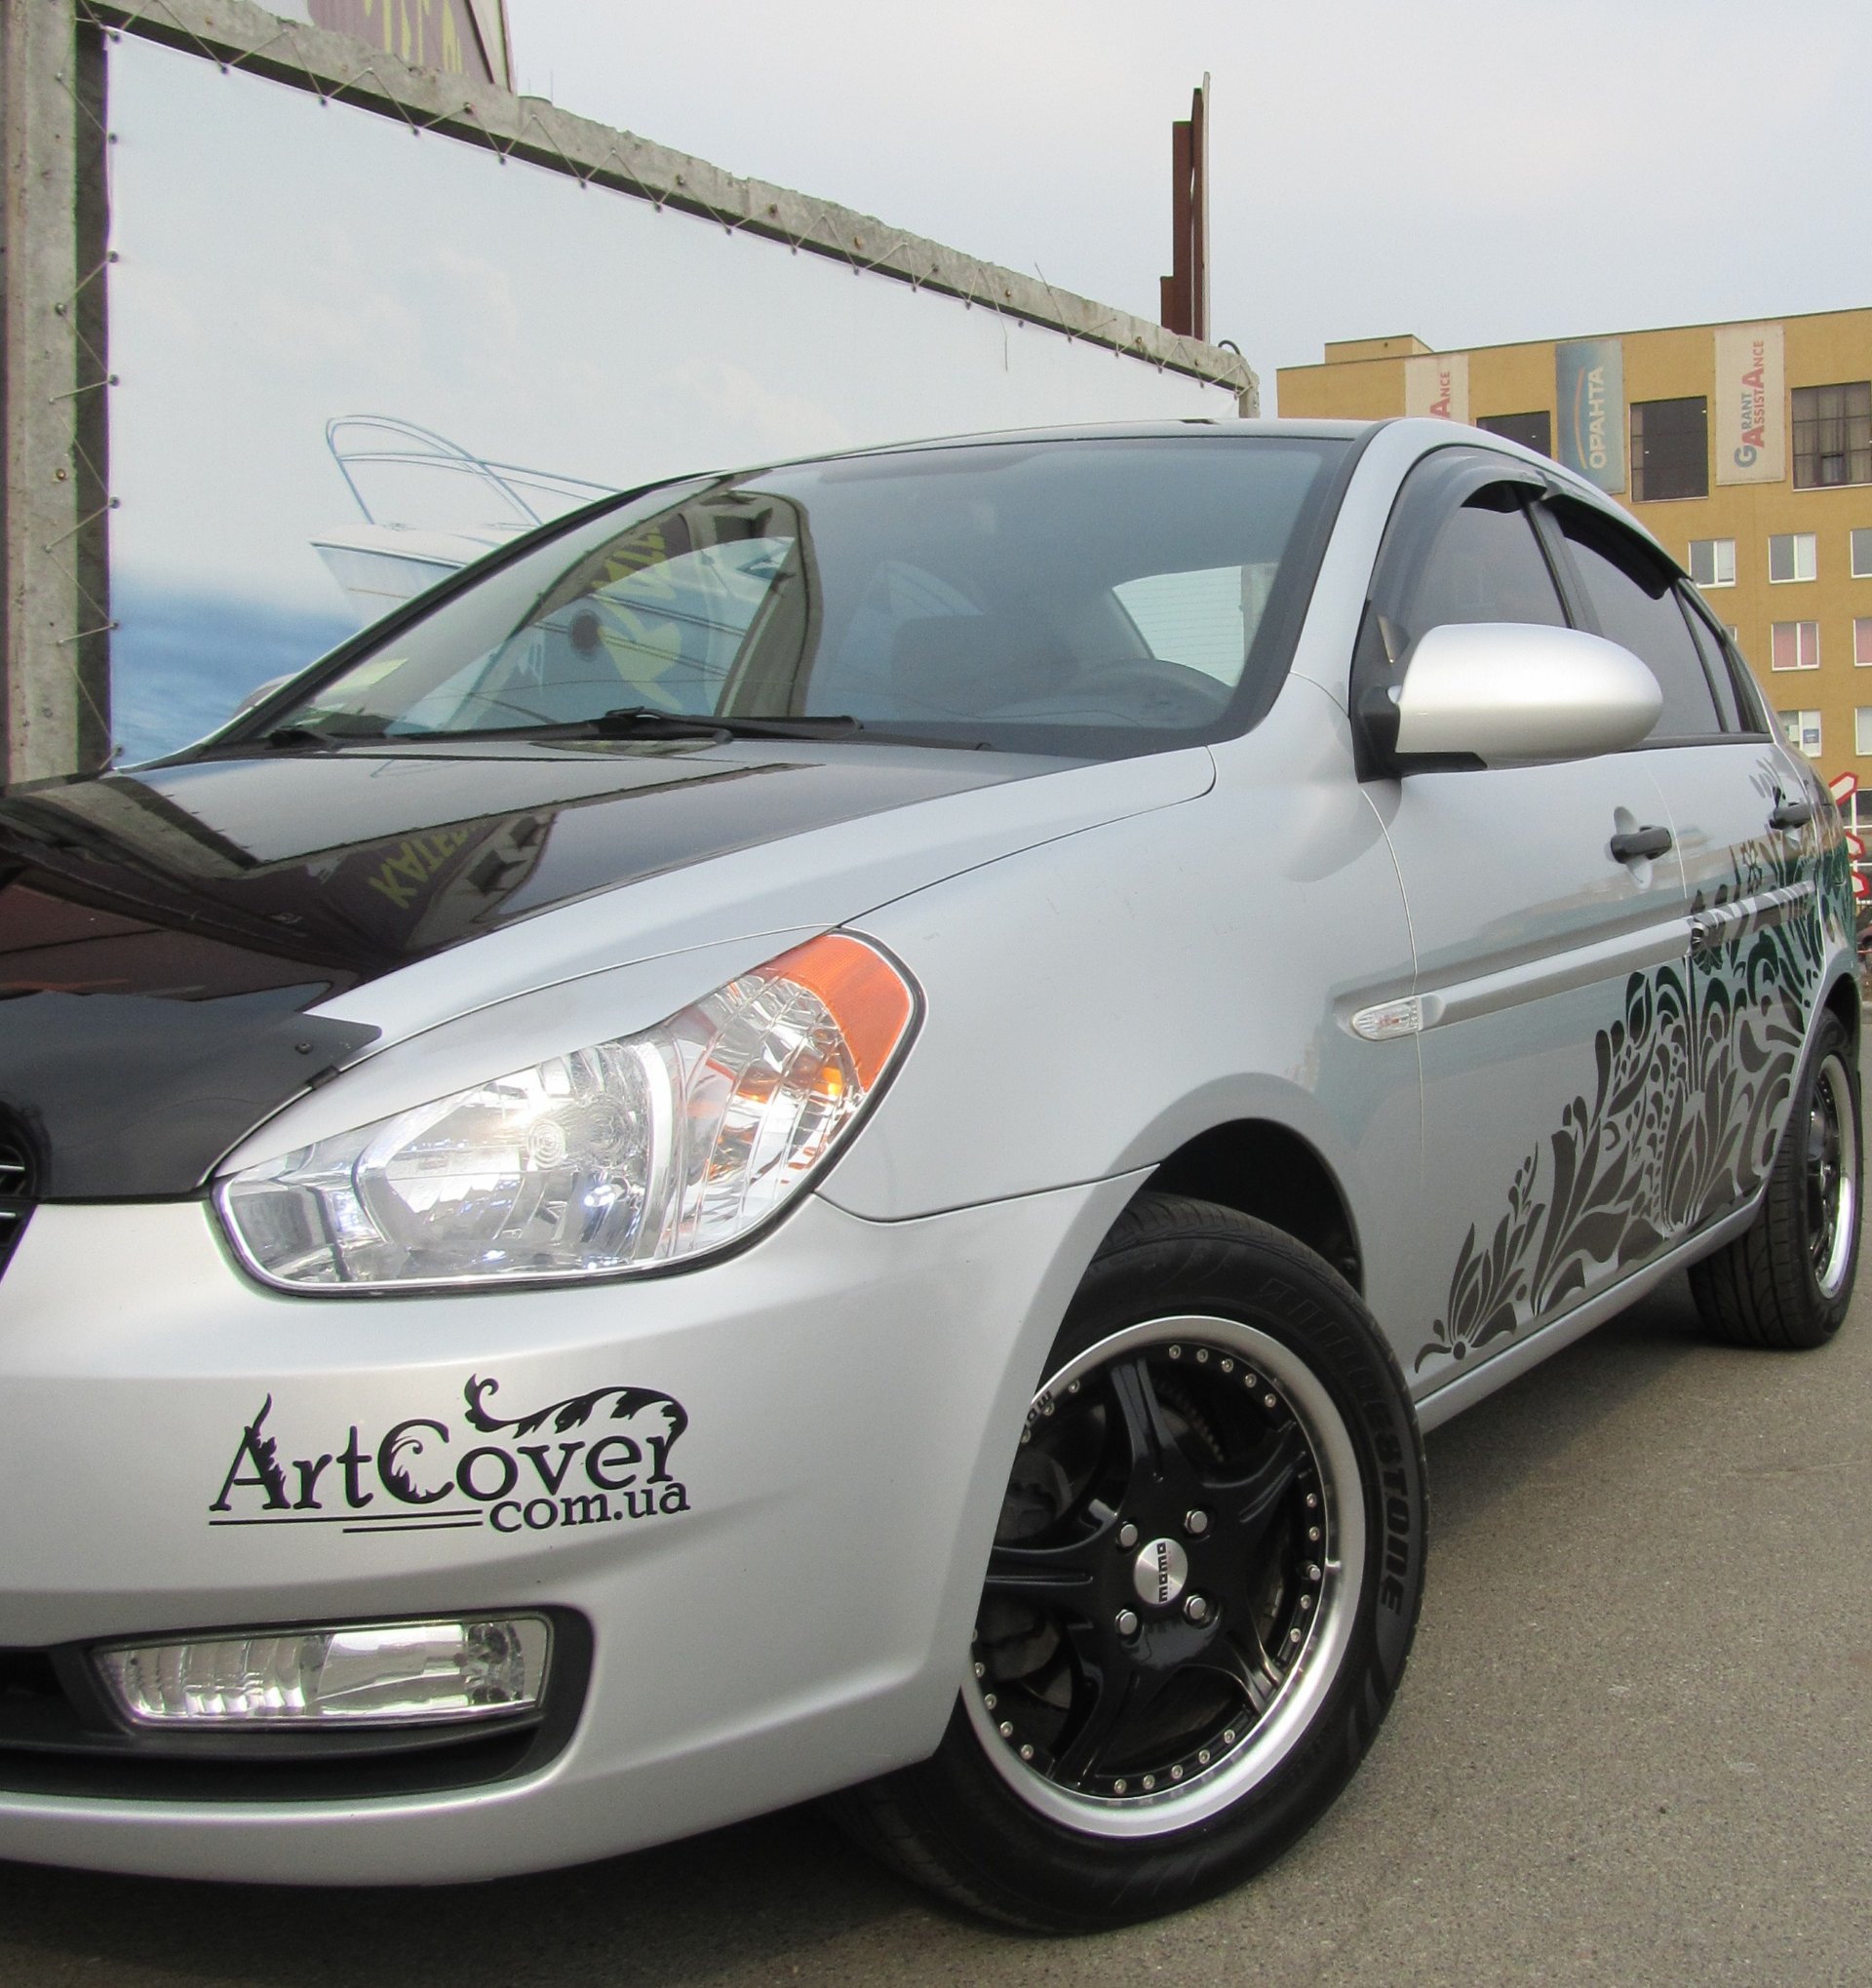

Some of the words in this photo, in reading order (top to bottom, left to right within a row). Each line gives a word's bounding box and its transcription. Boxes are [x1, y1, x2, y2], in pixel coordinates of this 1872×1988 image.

[1429, 371, 1451, 419] ANCE
[1588, 366, 1607, 470] ОРАНТА
[1734, 392, 1757, 468] GARANT
[1741, 340, 1766, 448] ASSISTANCE
[209, 1374, 688, 1510] ArtCover
[490, 1481, 690, 1533] com.ua
